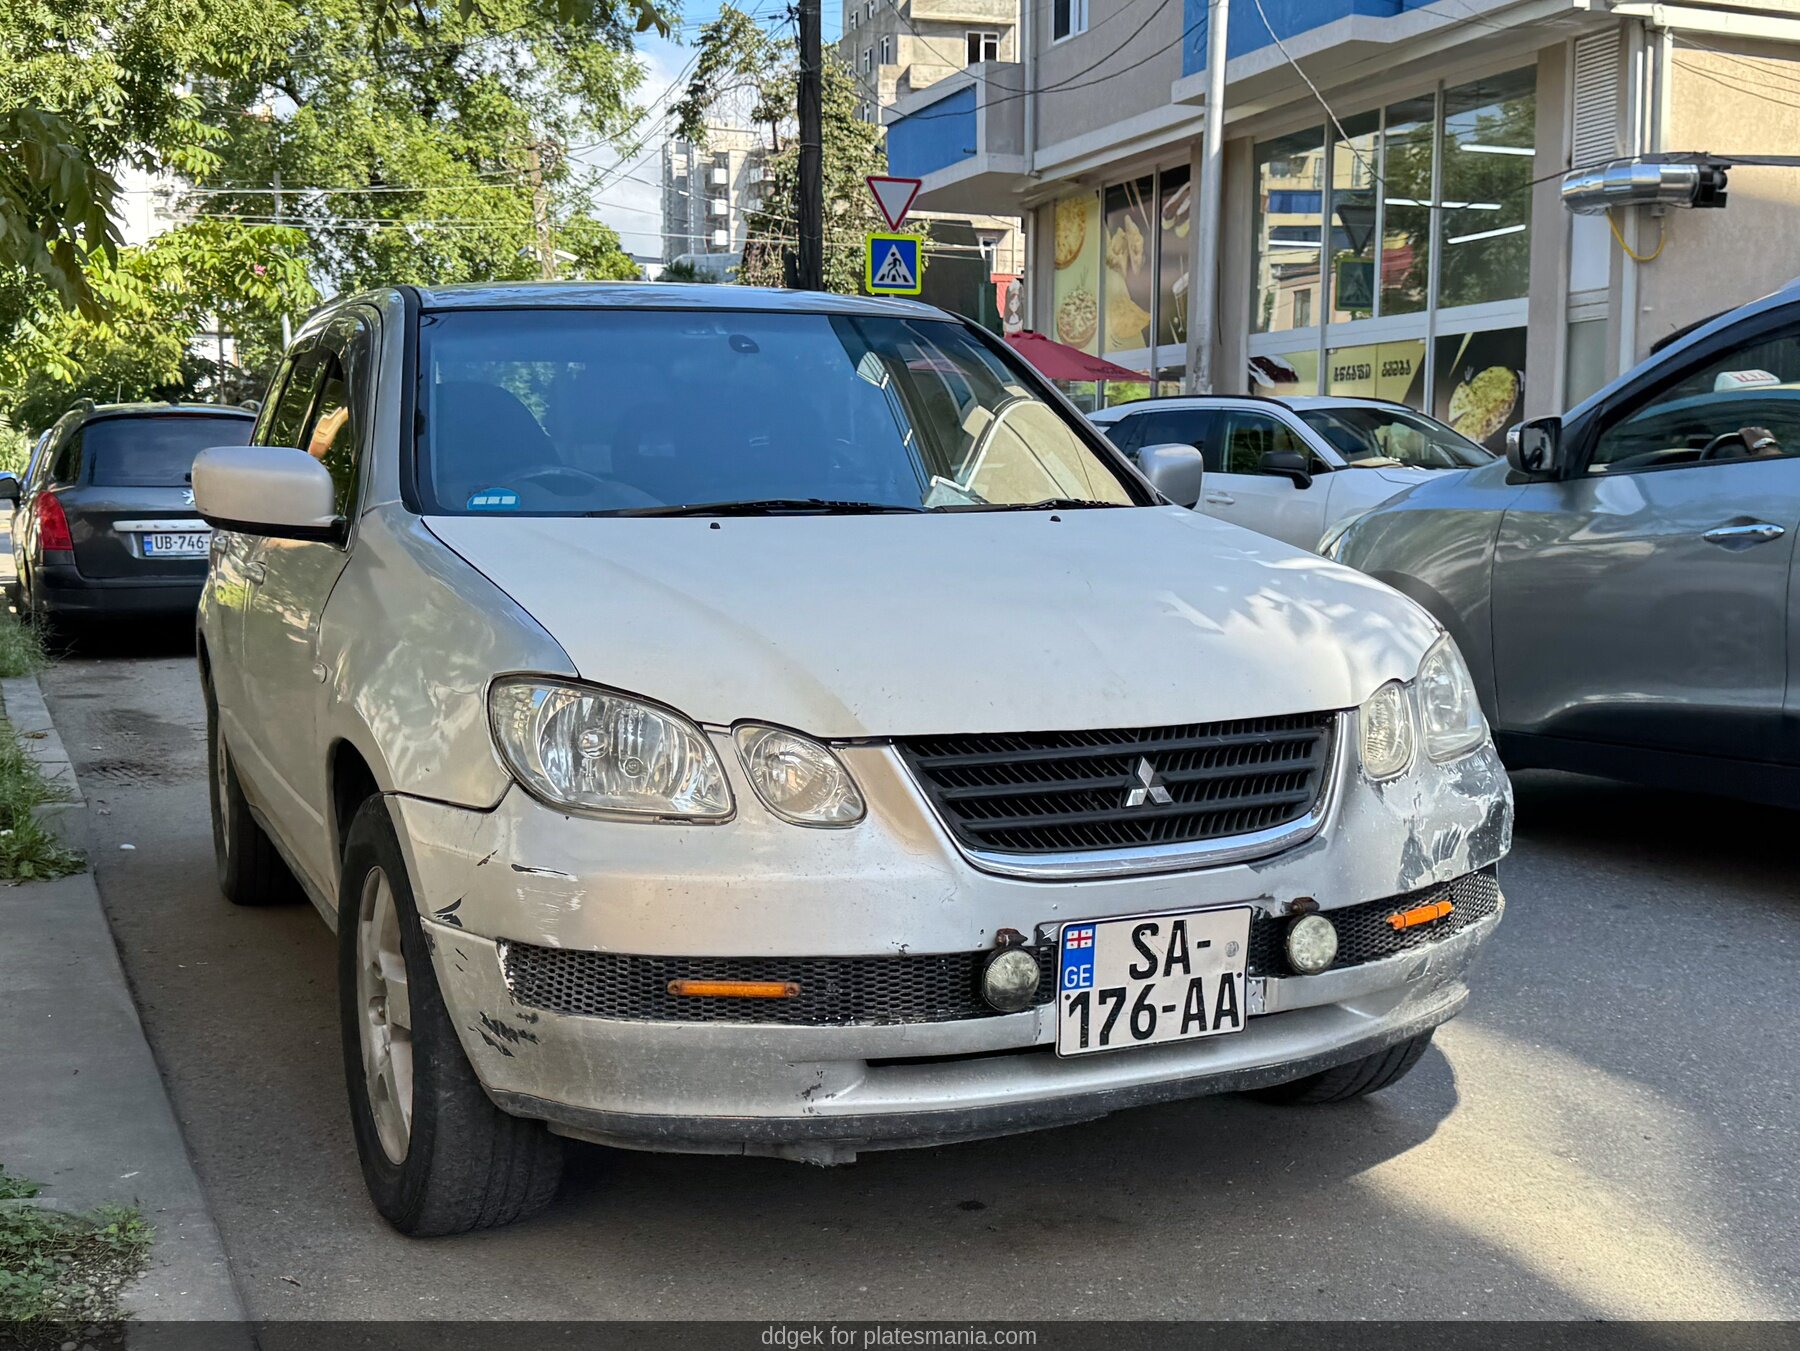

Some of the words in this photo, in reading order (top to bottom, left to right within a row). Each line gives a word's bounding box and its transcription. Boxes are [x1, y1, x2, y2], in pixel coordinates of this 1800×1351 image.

[155, 535, 209, 550] UB-746-
[1129, 919, 1211, 980] SA-
[1064, 964, 1091, 988] GE
[1068, 972, 1240, 1049] 176-AA
